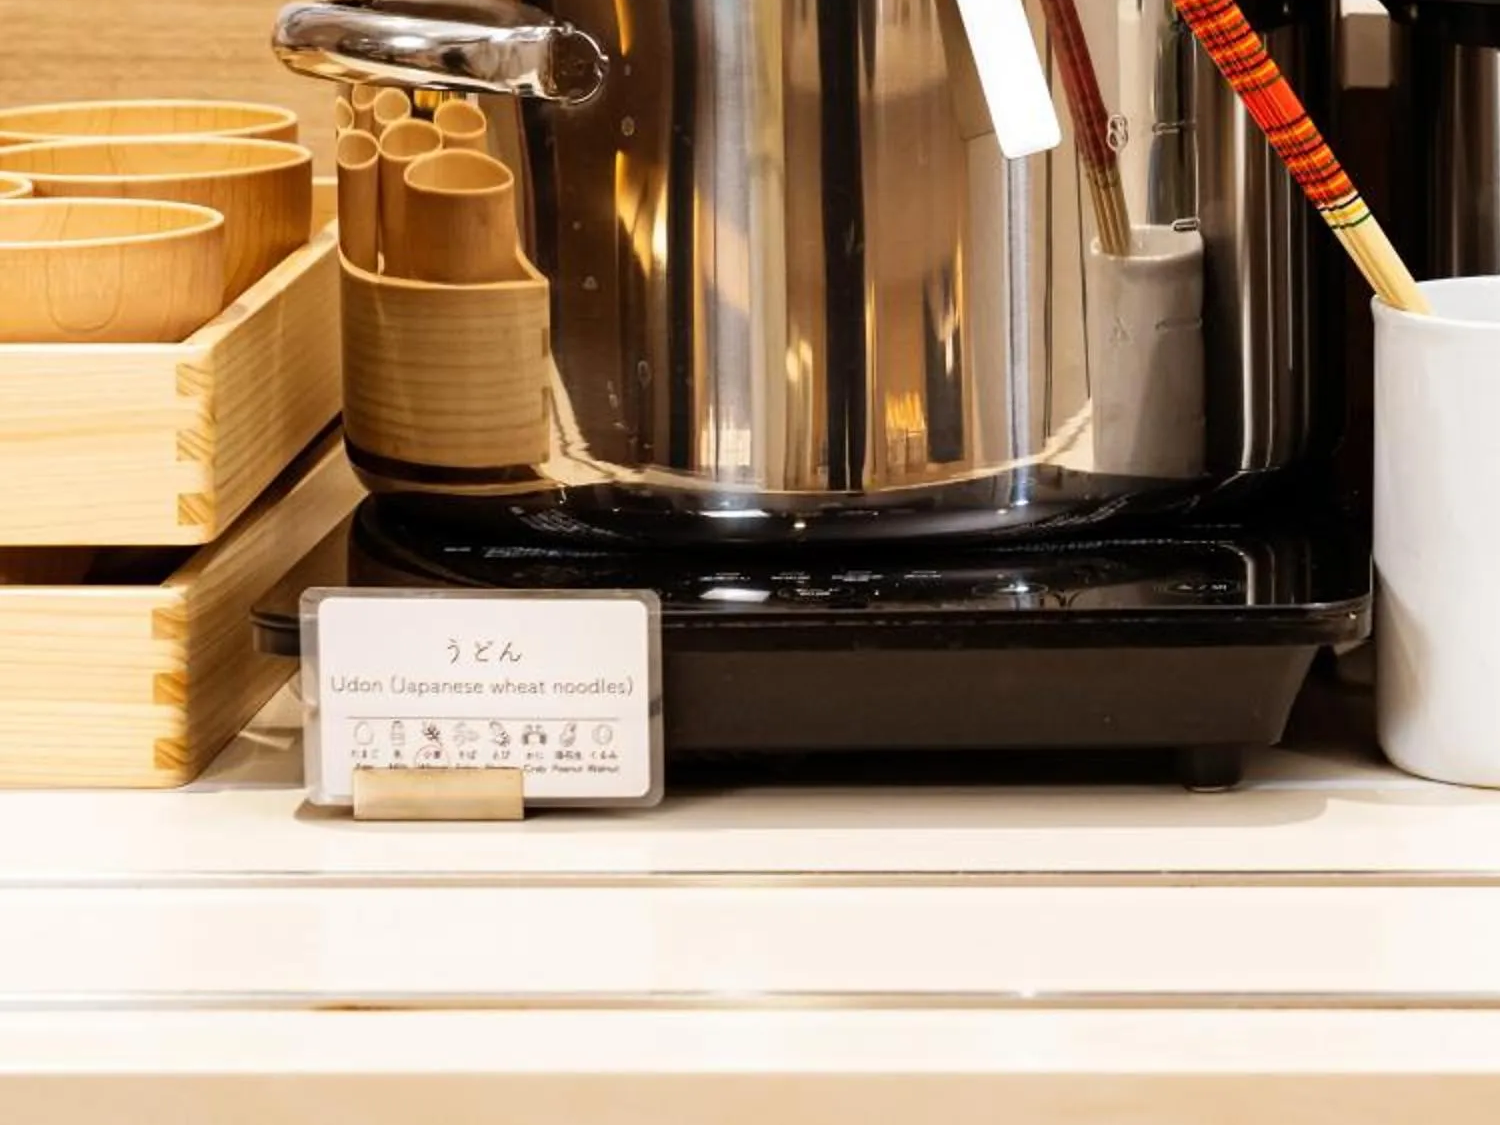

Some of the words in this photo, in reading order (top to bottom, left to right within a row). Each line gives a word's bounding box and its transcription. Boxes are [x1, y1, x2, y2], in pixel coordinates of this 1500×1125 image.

[446, 638, 523, 663] うどん
[331, 676, 383, 693] Udon
[390, 676, 484, 695] (Japanese
[492, 677, 545, 694] wheat
[553, 676, 634, 696] noodles)
